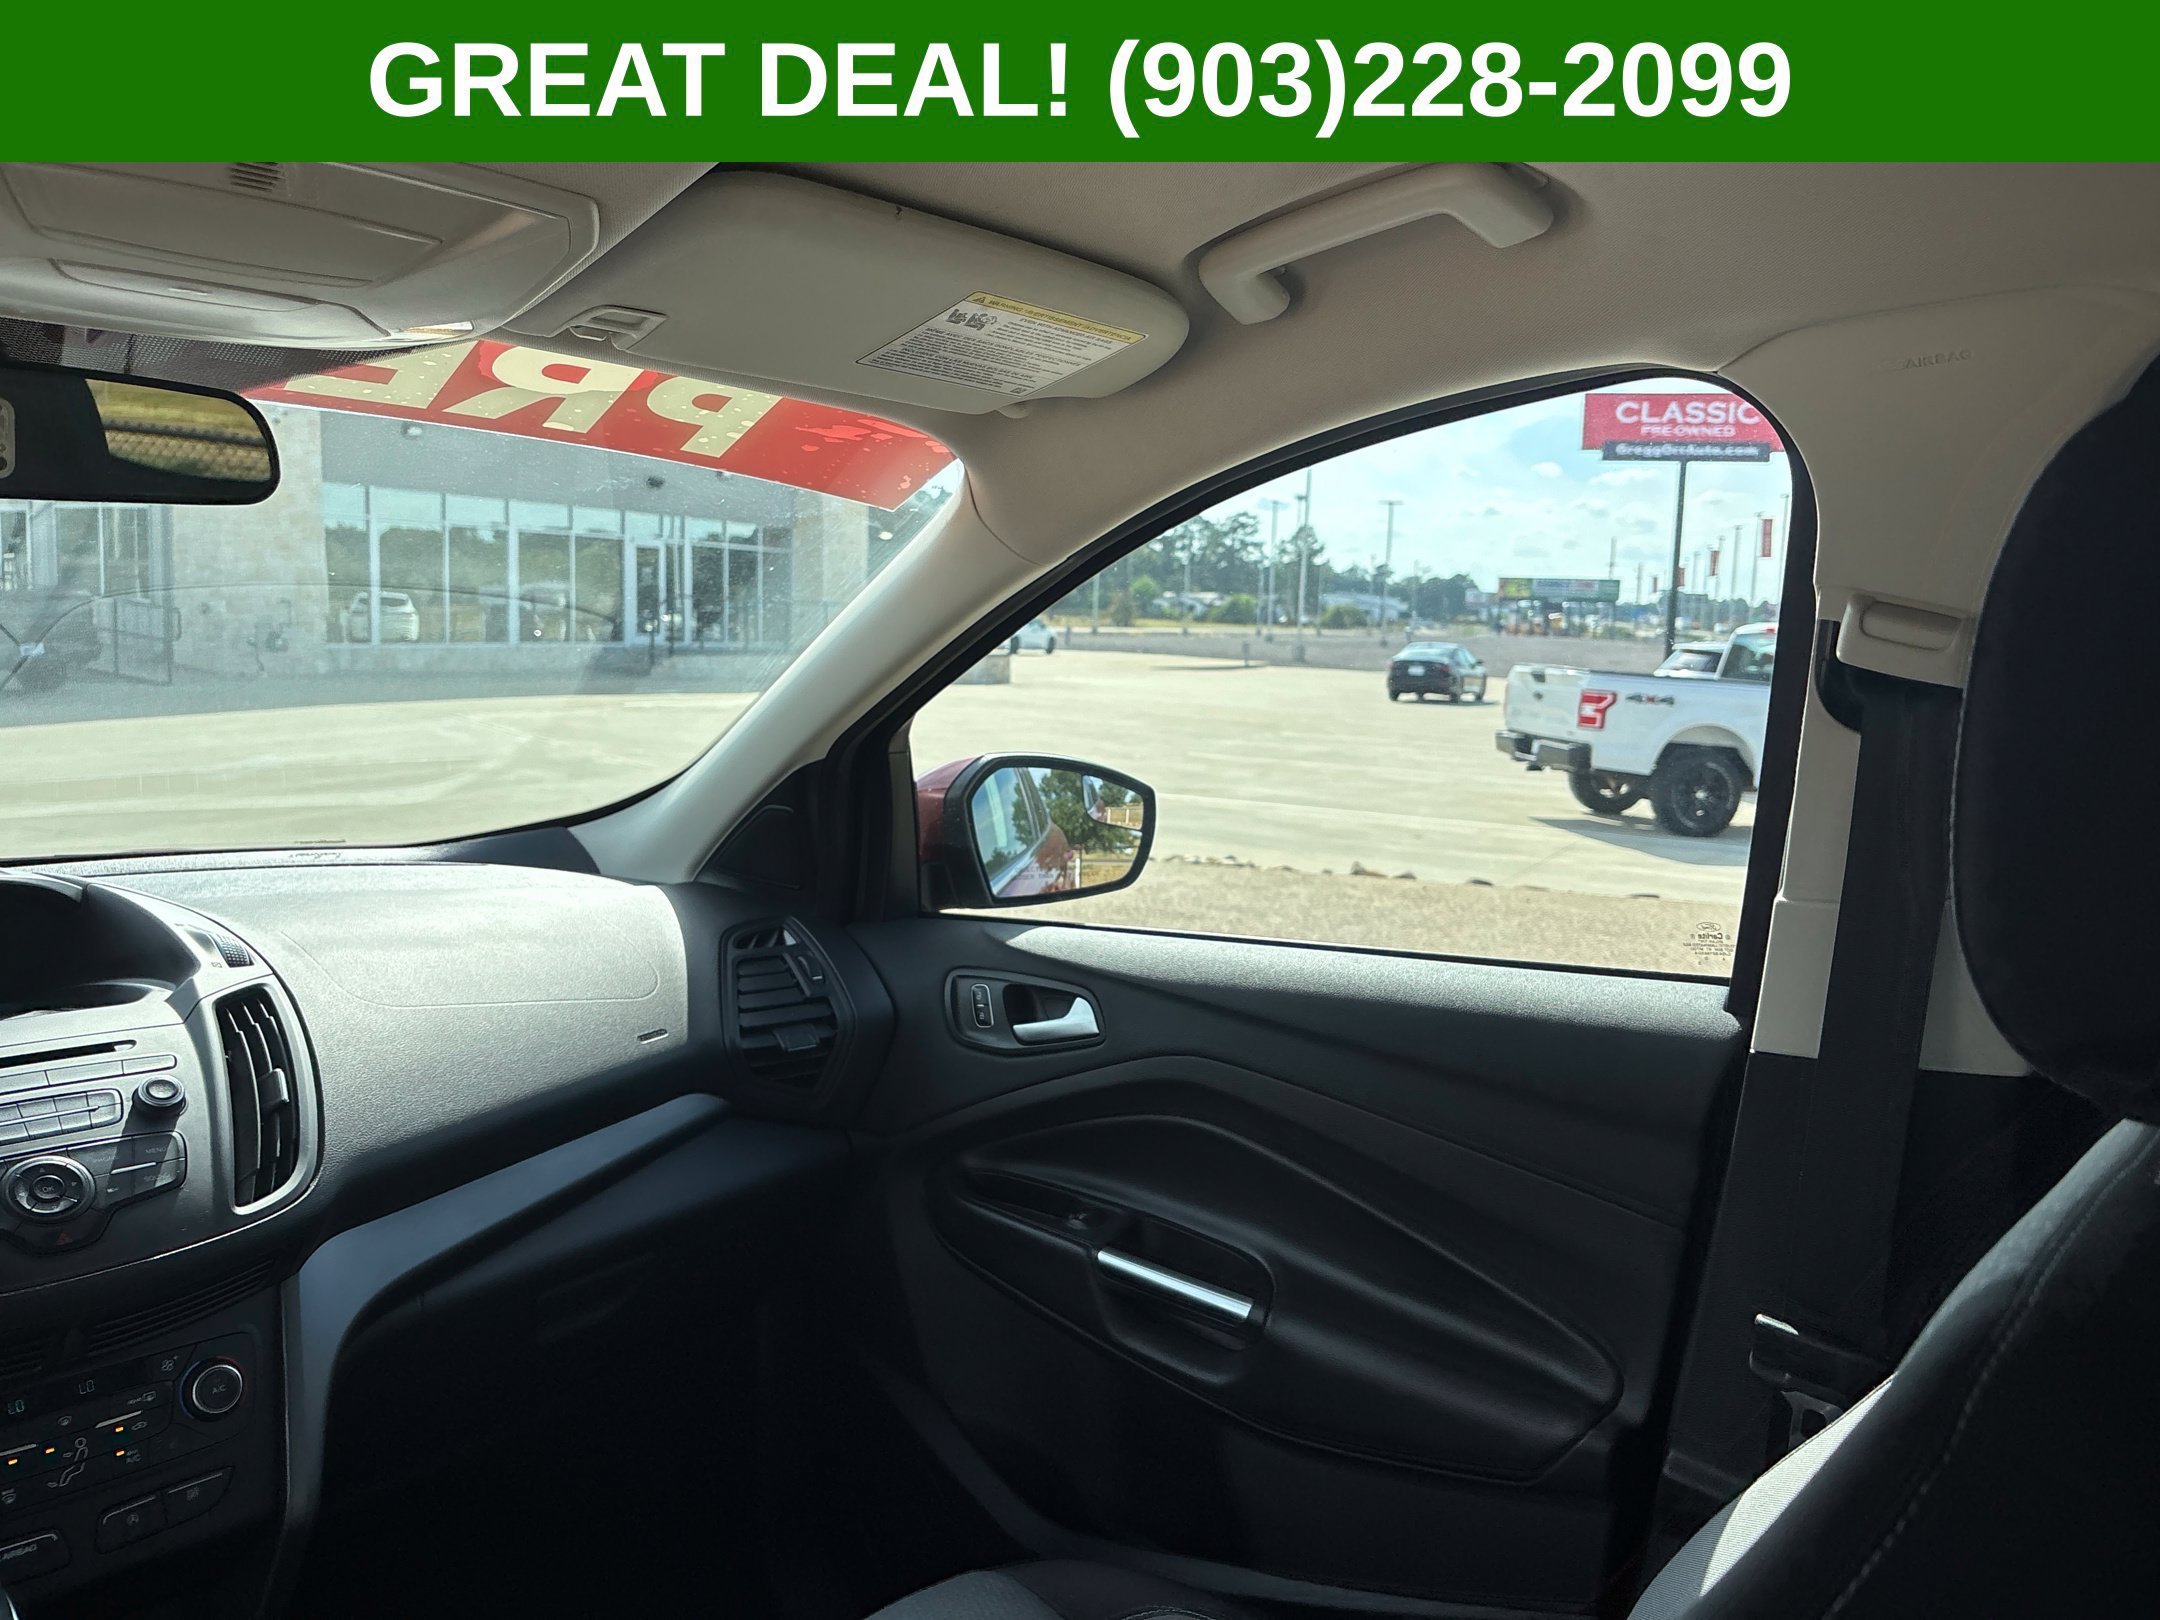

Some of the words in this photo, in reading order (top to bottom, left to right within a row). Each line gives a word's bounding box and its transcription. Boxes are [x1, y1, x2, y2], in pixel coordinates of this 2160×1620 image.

[987, 300, 1025, 313] WARNING
[1905, 350, 1972, 368] AIRBAG
[1615, 401, 1761, 425] CLASSIC
[1640, 425, 1737, 437] PRE-OWNED
[42, 1185, 54, 1193] OK
